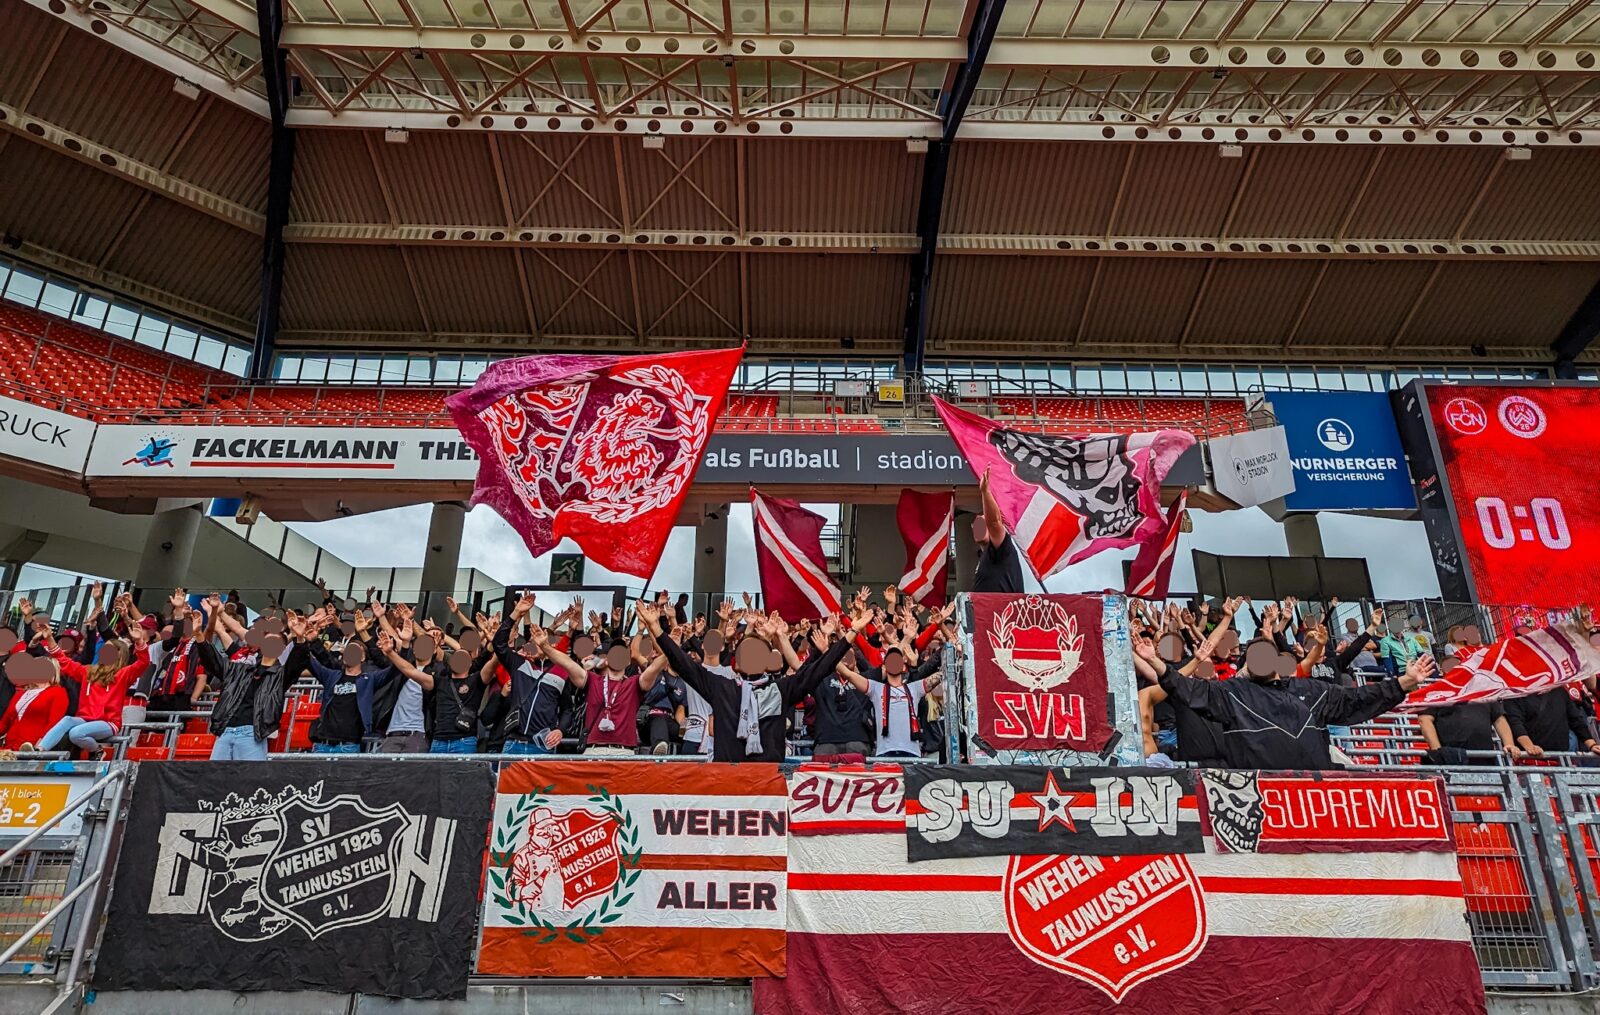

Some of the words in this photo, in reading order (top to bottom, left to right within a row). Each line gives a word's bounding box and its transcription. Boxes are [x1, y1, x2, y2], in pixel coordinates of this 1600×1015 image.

[885, 390, 897, 399] 26
[1450, 413, 1484, 427] FCN
[192, 438, 399, 460] FACKELMANN
[419, 441, 479, 460] THE
[705, 448, 741, 468] als
[749, 448, 840, 468] Fußball
[1290, 457, 1397, 470] NÜRNBERGER
[1306, 472, 1385, 481] VERSICHERUNG
[1474, 497, 1571, 549] 0:0
[993, 691, 1086, 741] SVW
[18, 789, 42, 798] block
[791, 775, 905, 815] SUPC
[652, 809, 787, 837] WEHEN
[917, 778, 1015, 843] SU
[1090, 775, 1183, 837] IN
[1263, 788, 1440, 830] SUPREMUS
[300, 813, 331, 843] SV
[552, 820, 571, 843] SV
[578, 826, 607, 848] 1926
[274, 843, 338, 878] WEHEN
[340, 827, 383, 855] 1926
[279, 853, 387, 904] TAUNUSSTEIN
[574, 873, 597, 893] e.V.
[1018, 855, 1105, 912] WEHEN
[322, 893, 354, 917] e.V.
[656, 881, 778, 911] ALLER
[1041, 855, 1181, 951] TAUNUSSTEIN
[1113, 923, 1157, 954] e.V.
